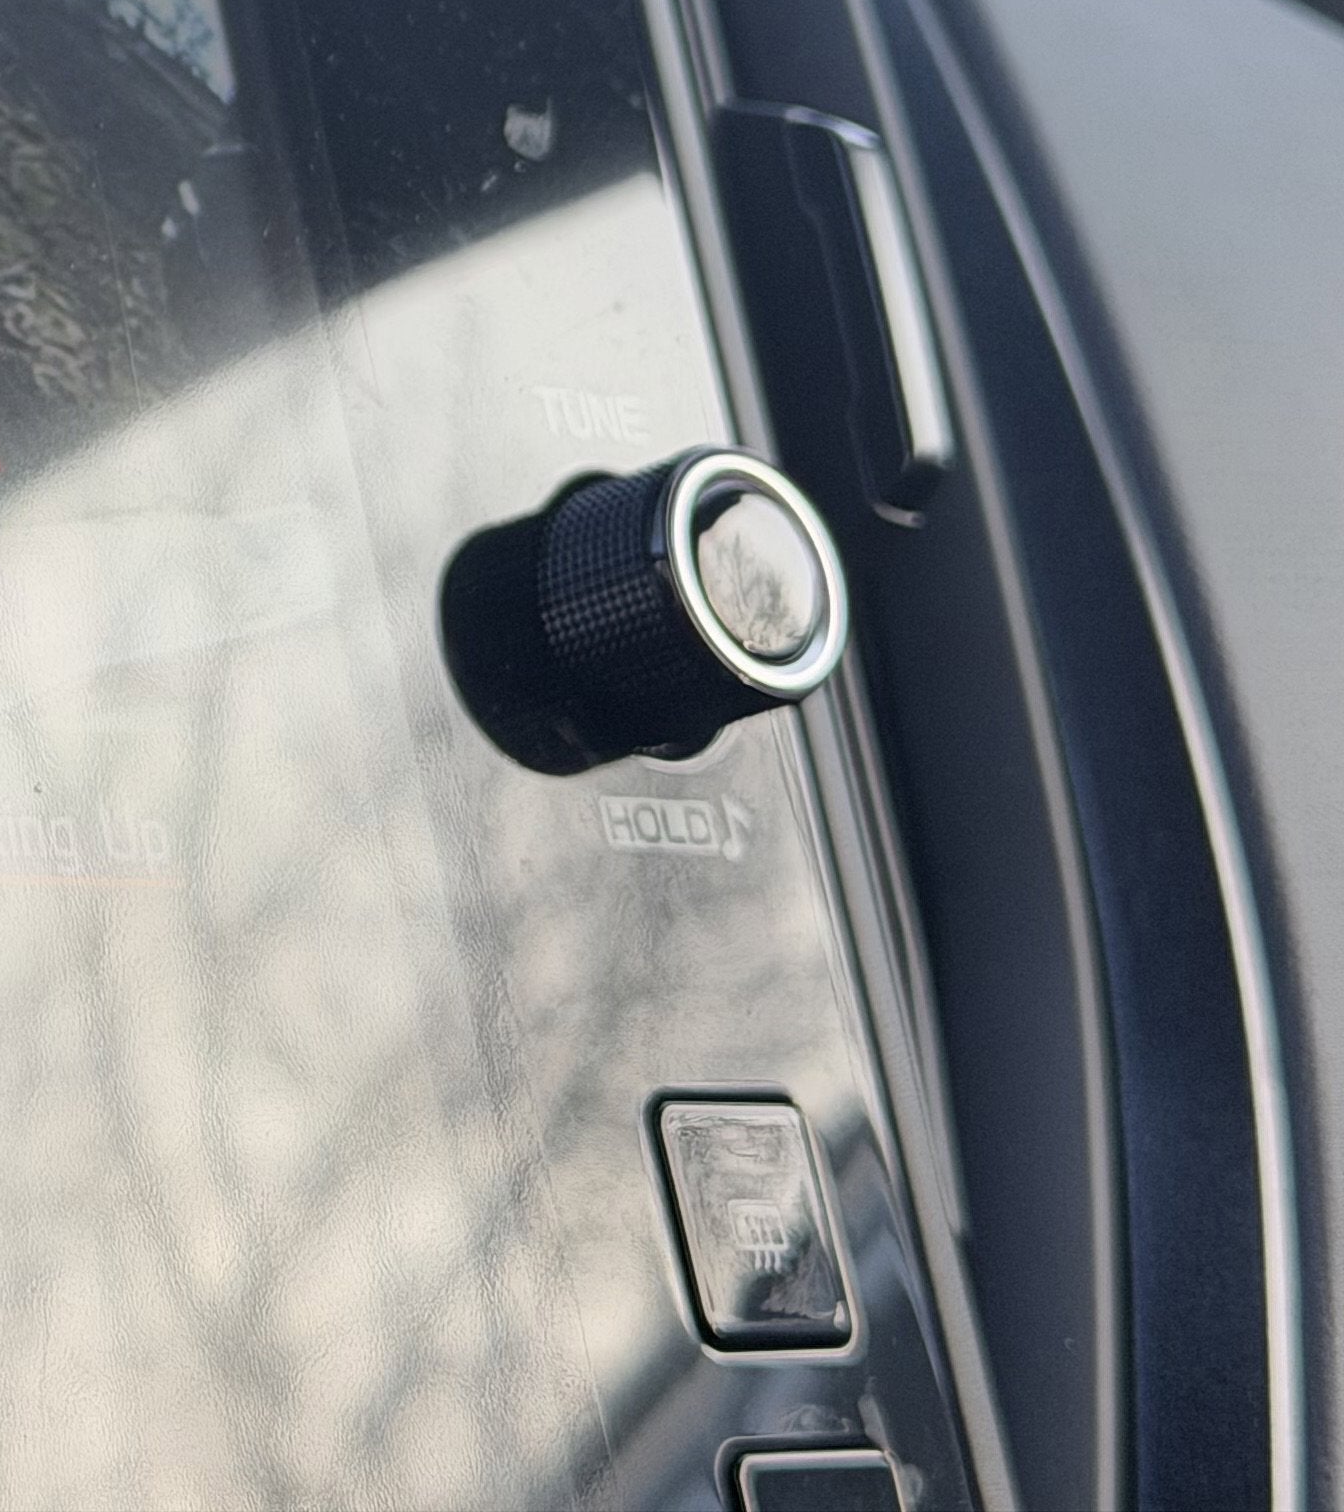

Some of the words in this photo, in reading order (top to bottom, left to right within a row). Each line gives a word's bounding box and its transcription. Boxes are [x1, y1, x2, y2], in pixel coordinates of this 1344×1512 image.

[530, 385, 651, 449] TUNE
[98, 800, 171, 875] Up
[606, 802, 711, 845] HOLD
